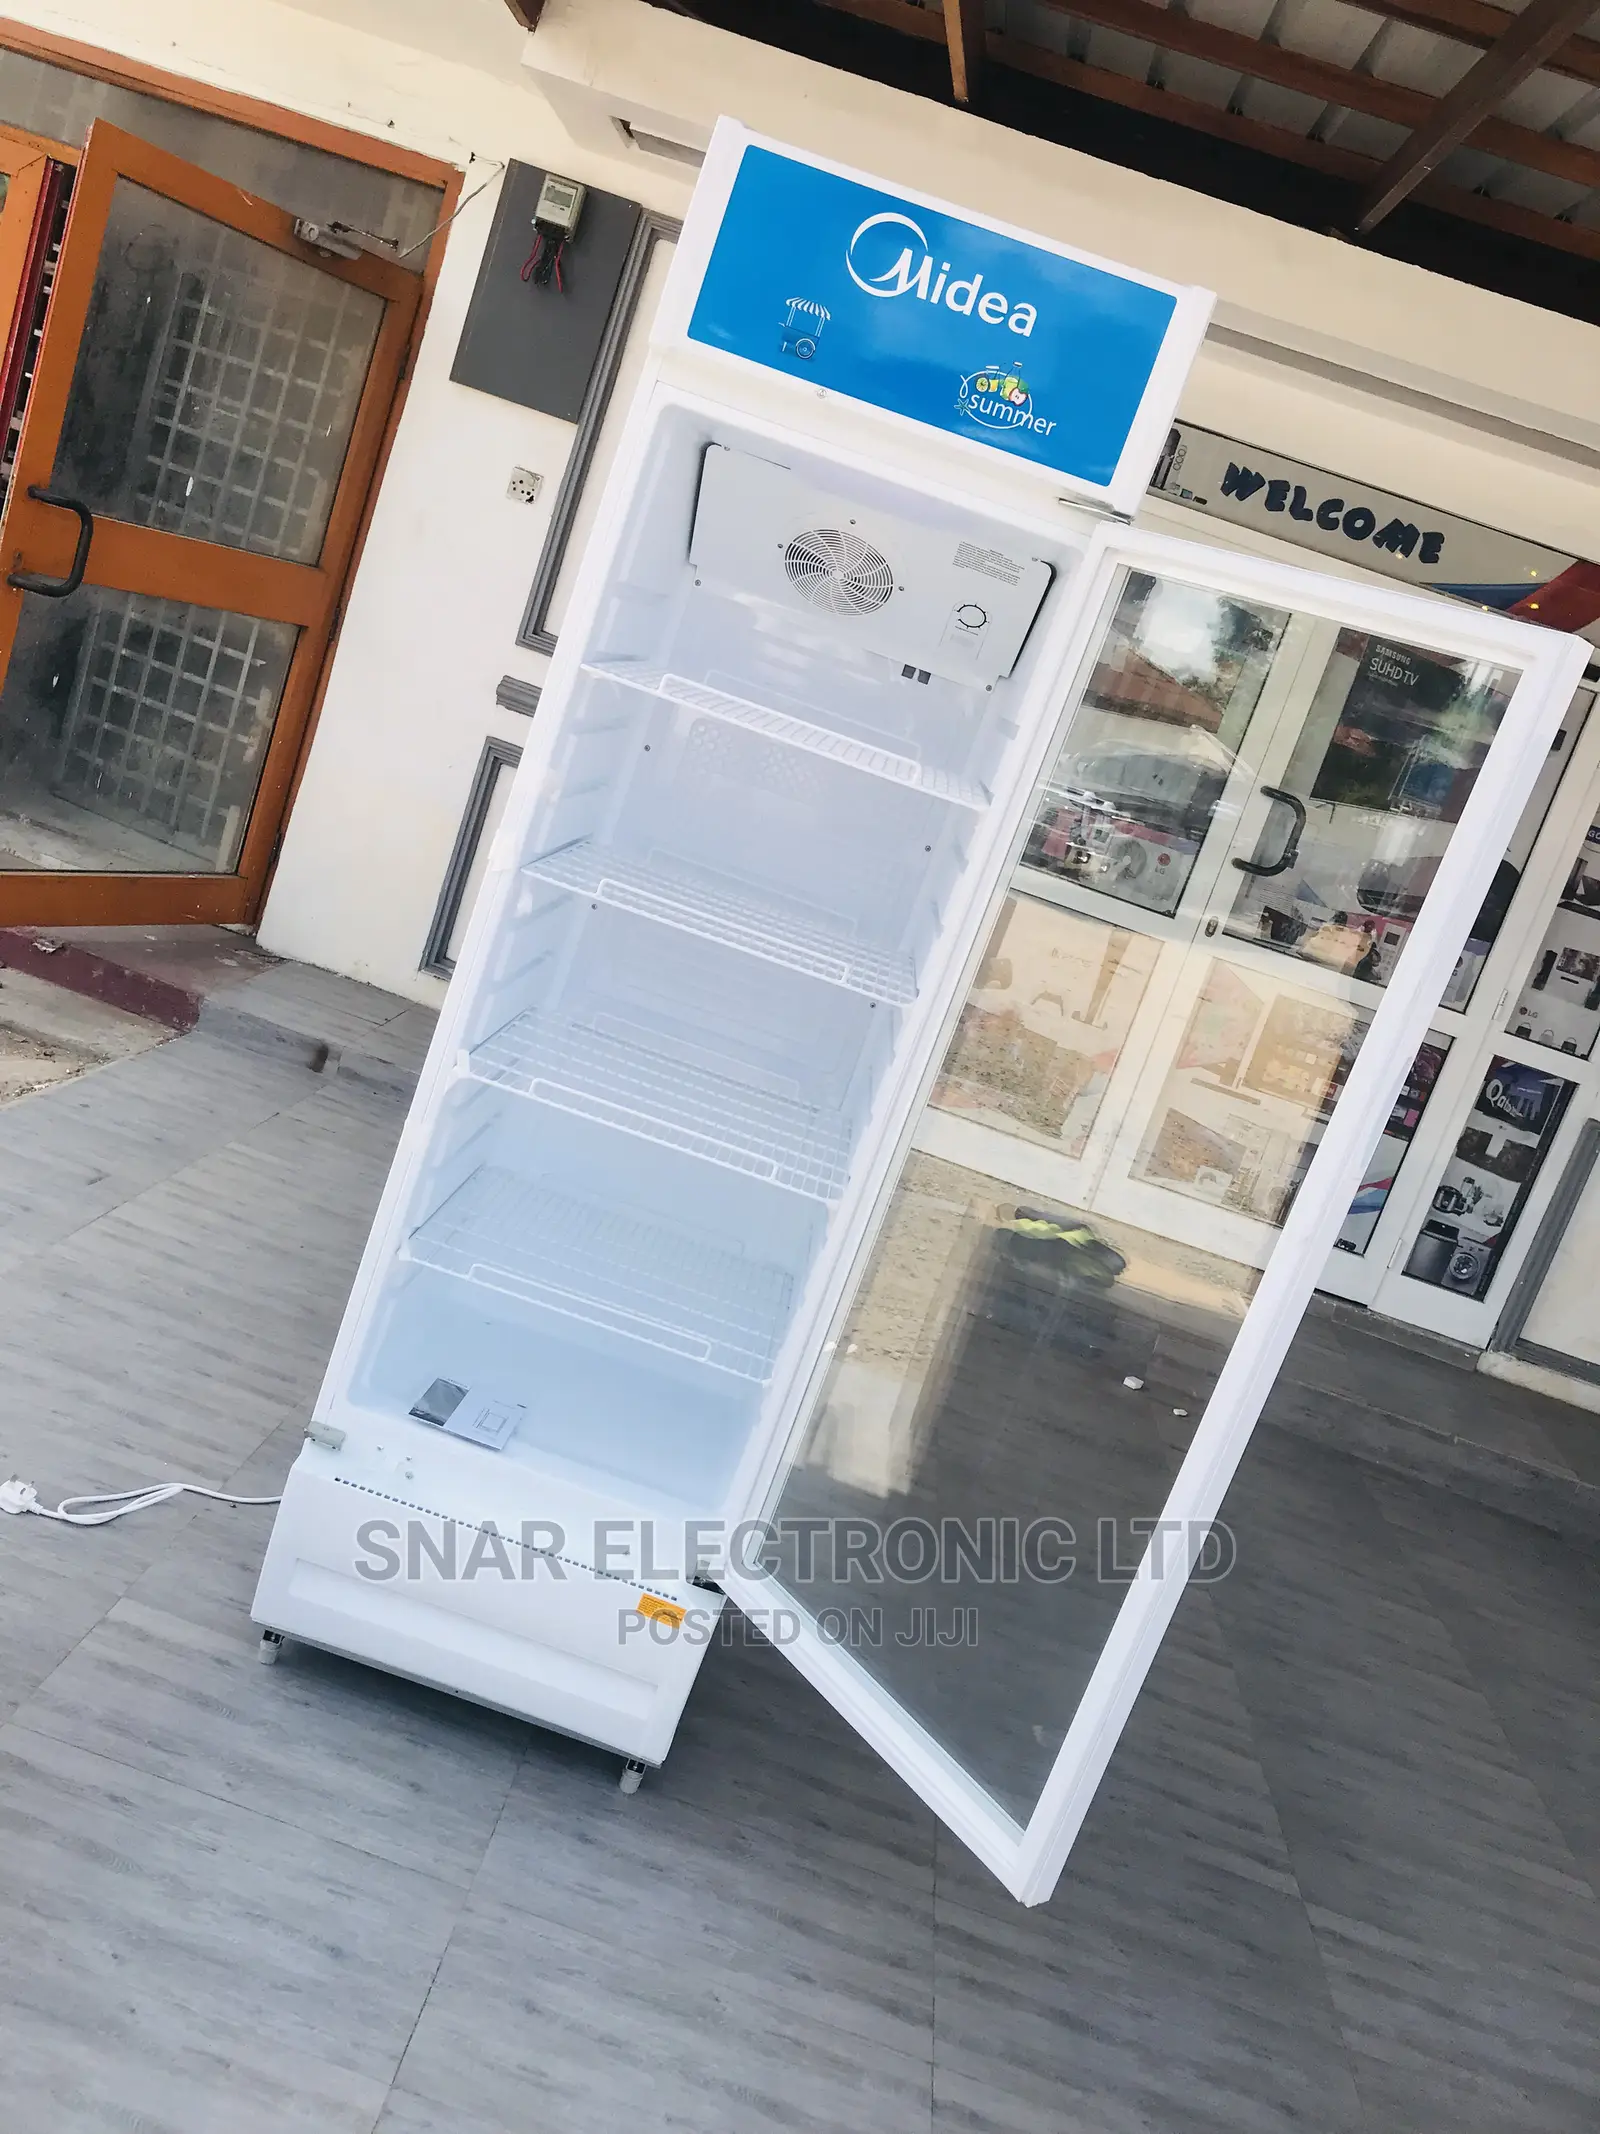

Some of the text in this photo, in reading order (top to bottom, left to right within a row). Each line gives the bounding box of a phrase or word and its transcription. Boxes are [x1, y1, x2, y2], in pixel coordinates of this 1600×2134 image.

[868, 245, 1038, 338] Midea
[967, 393, 1057, 436] summer
[1220, 461, 1446, 564] WELCOME
[1375, 644, 1412, 665] SAMSUNG
[1527, 1010, 1539, 1019] LG
